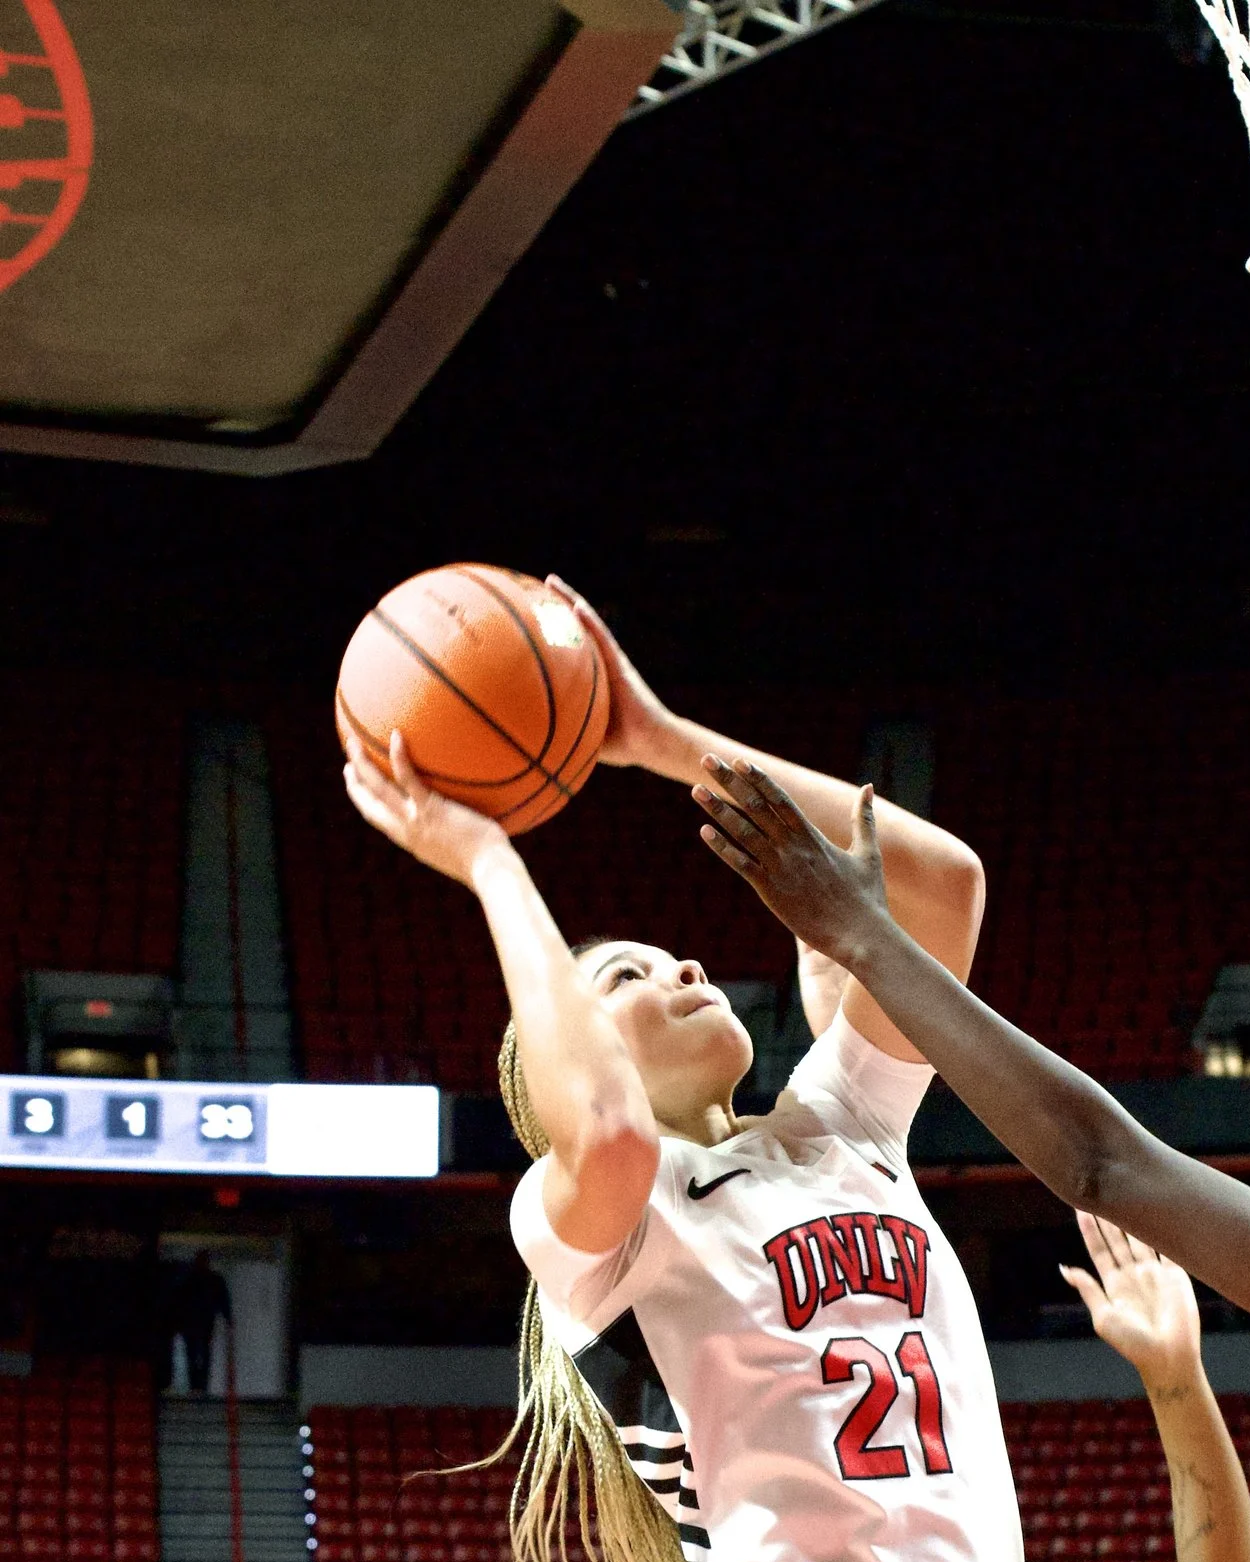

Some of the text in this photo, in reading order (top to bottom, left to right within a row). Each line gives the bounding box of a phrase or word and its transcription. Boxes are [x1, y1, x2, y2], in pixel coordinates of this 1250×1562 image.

[25, 1098, 54, 1133] 3
[122, 1102, 146, 1136] 1
[762, 1211, 931, 1332] UNLV
[820, 1331, 954, 1481] 21
